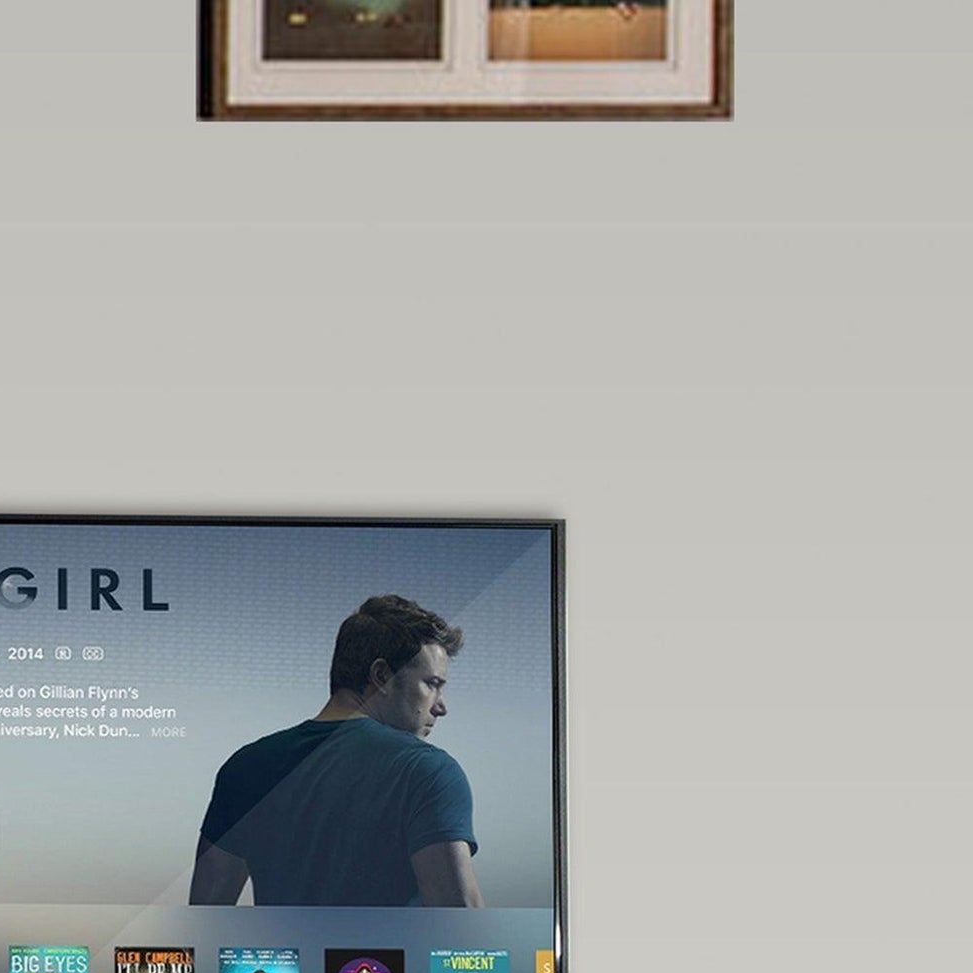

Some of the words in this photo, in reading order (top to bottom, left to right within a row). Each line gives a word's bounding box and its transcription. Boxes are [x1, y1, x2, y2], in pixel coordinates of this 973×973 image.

[8, 647, 44, 660] 2014
[18, 688, 36, 699] on
[39, 685, 84, 699] Gillian
[35, 705, 88, 719] secrets
[91, 705, 107, 719] of
[109, 708, 118, 719] a
[121, 706, 177, 719] modern
[63, 724, 95, 738] Nick
[151, 727, 187, 738] MORE
[11, 955, 40, 973] BIG
[44, 955, 88, 973] EYES
[116, 951, 140, 964] GLEN
[145, 951, 192, 965] CAMPBELL
[450, 956, 495, 970] VINCENT
